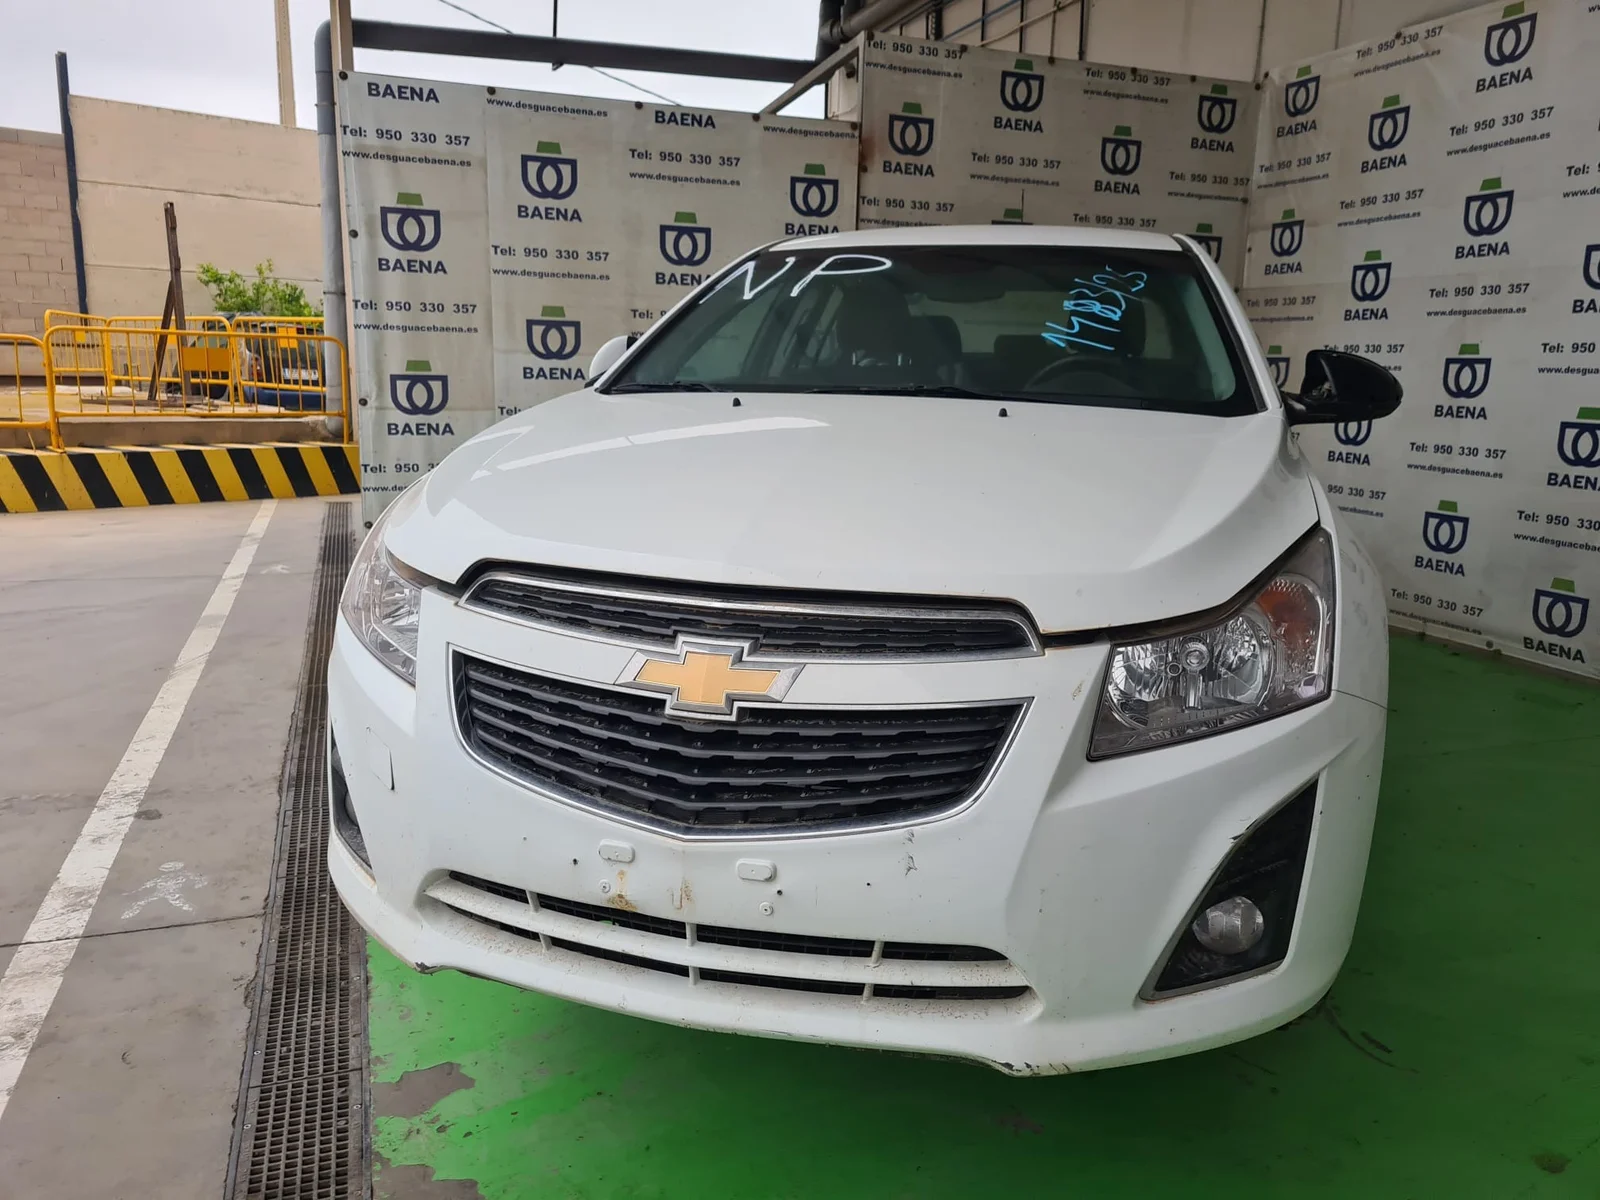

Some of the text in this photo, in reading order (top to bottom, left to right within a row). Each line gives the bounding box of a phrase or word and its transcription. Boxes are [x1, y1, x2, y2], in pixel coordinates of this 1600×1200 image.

[866, 40, 964, 60] Tel: 950 330 357
[1356, 26, 1443, 59] Tel: 950 330 357
[1085, 67, 1170, 86] Tel: 950 330 357
[1476, 67, 1533, 93] BAENA
[367, 82, 439, 103] BAENA
[486, 97, 608, 117] www.desguacebaena.es
[655, 110, 716, 129] BAENA
[994, 116, 1043, 133] BAENA
[1450, 107, 1554, 137] Tel: 950 330 357
[340, 125, 470, 146] Tel: 950 330 357
[763, 124, 857, 140] www.desguacebaena.
[1277, 120, 1317, 137] BAENA
[1191, 137, 1234, 153] BAENA
[1446, 132, 1551, 156] www.desguacebaena.es
[342, 150, 471, 167] www.desguacebaena.es
[629, 149, 740, 167] Tel: 950 330 357
[971, 152, 1061, 170] Tel: 950 330 357
[1360, 154, 1407, 174] BAENA
[883, 161, 934, 177] BAENA
[1566, 163, 1589, 177] Tel:
[629, 171, 740, 186] www.desguacebaena.es
[1169, 171, 1249, 186] Tel: 950 330 357
[1094, 180, 1140, 195] BAENA
[860, 196, 954, 213] Tel: 950 330 357
[1339, 189, 1424, 210] Tel: 950 330 357
[517, 205, 582, 222] BAENA
[1073, 213, 1157, 227] Tel: 950 330 357
[492, 245, 609, 262] Tel: 950 330 357
[1455, 242, 1510, 259] BAENA
[378, 258, 447, 274] BAENA
[1264, 263, 1303, 275] BAENA
[492, 268, 610, 281] www.desguacebaena.es
[1429, 283, 1529, 298] Tel: 950 330 357
[352, 300, 477, 314] Tel: 950 330 357
[631, 310, 653, 319] Tel:
[1344, 308, 1388, 321] BAENA
[1427, 306, 1526, 317] www.desguacebaena.es
[353, 323, 478, 333] www.desguacebaena.es
[1344, 344, 1359, 353] 950
[1364, 344, 1381, 354] 330
[1386, 344, 1404, 353] 357
[1541, 342, 1596, 354] Tel: 950
[523, 367, 585, 380] BAENA
[1538, 365, 1600, 376] www.desgua
[1434, 405, 1487, 420] BAENA
[388, 423, 454, 436] BAENA
[1328, 451, 1371, 466] BAENA
[1410, 443, 1506, 460] Tel: 950 330 357
[362, 464, 386, 473] Tel:
[395, 464, 419, 473] 950
[1407, 463, 1503, 479] www.desguacebaena.es
[1547, 472, 1600, 491] BAEN
[1327, 484, 1386, 500] 950 330 357
[1517, 510, 1600, 531] Tel: 950 330
[1414, 556, 1465, 576] BAENA
[1391, 589, 1483, 617] Tel: 950 330 357
[1523, 636, 1585, 664] BAENA
